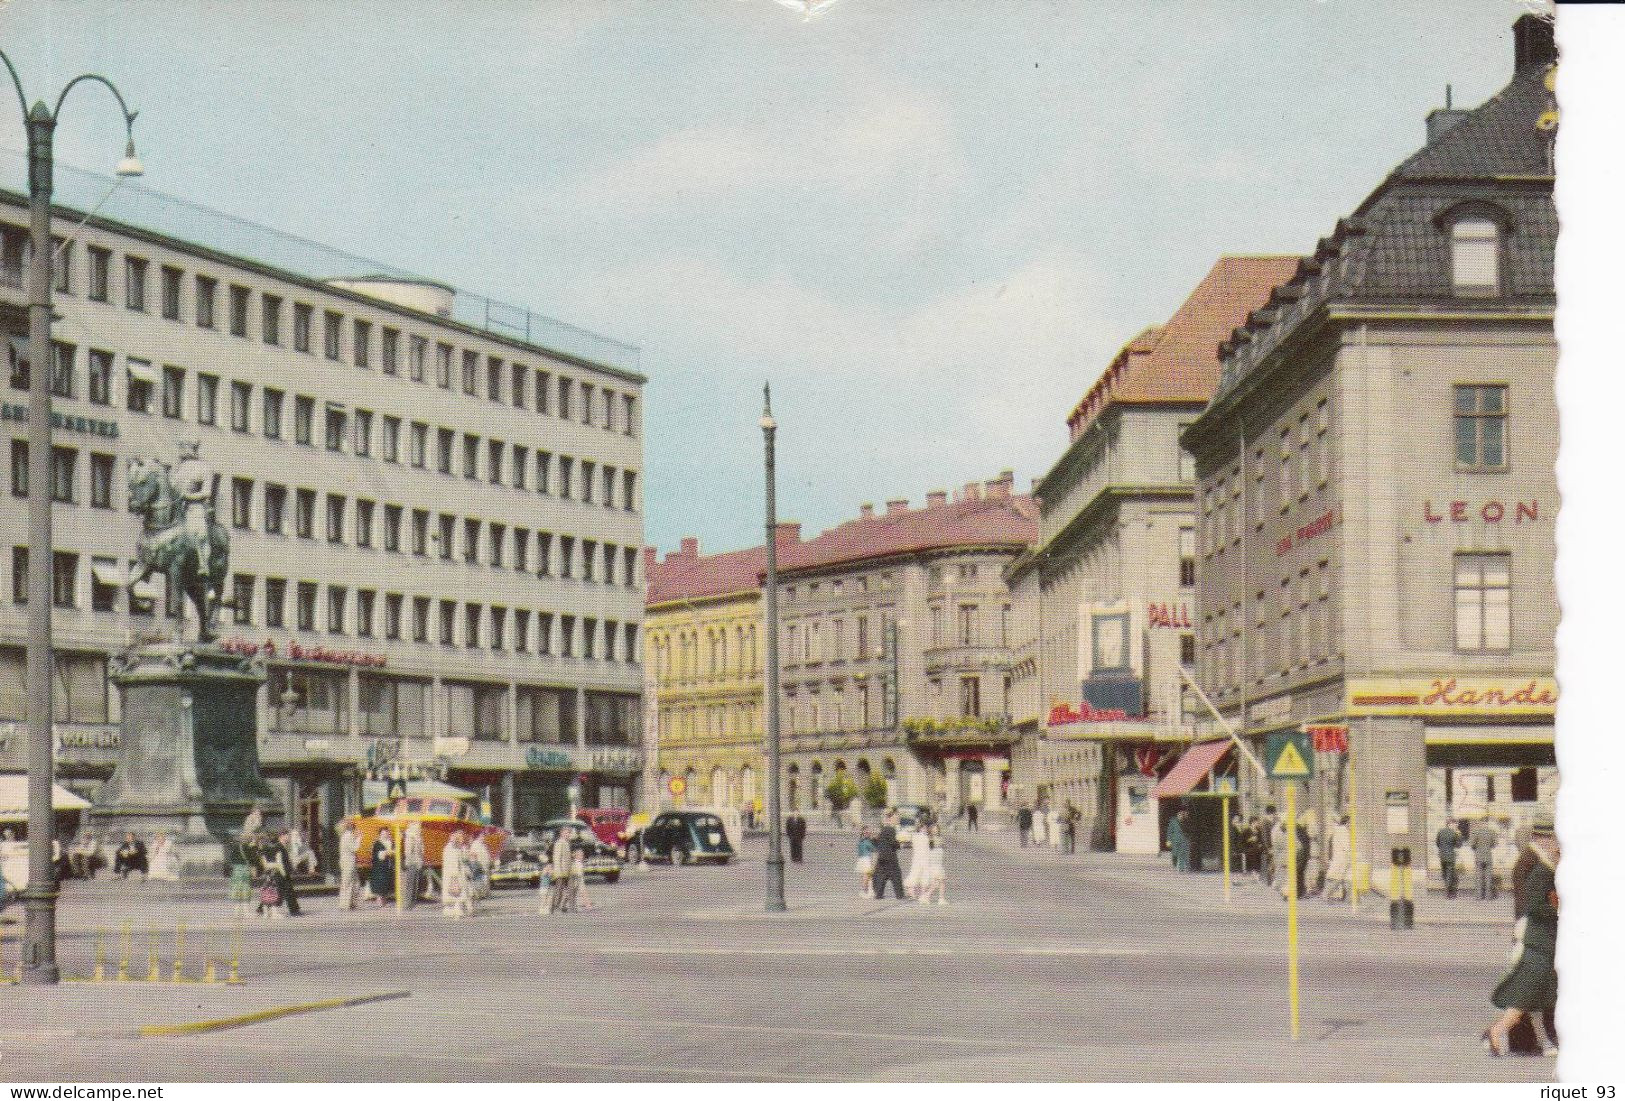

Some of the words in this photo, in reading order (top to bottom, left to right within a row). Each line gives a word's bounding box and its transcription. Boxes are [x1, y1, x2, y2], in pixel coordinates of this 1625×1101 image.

[1424, 500, 1539, 523] LEON
[1149, 602, 1191, 628] PALL
[1423, 678, 1557, 705] Hande
